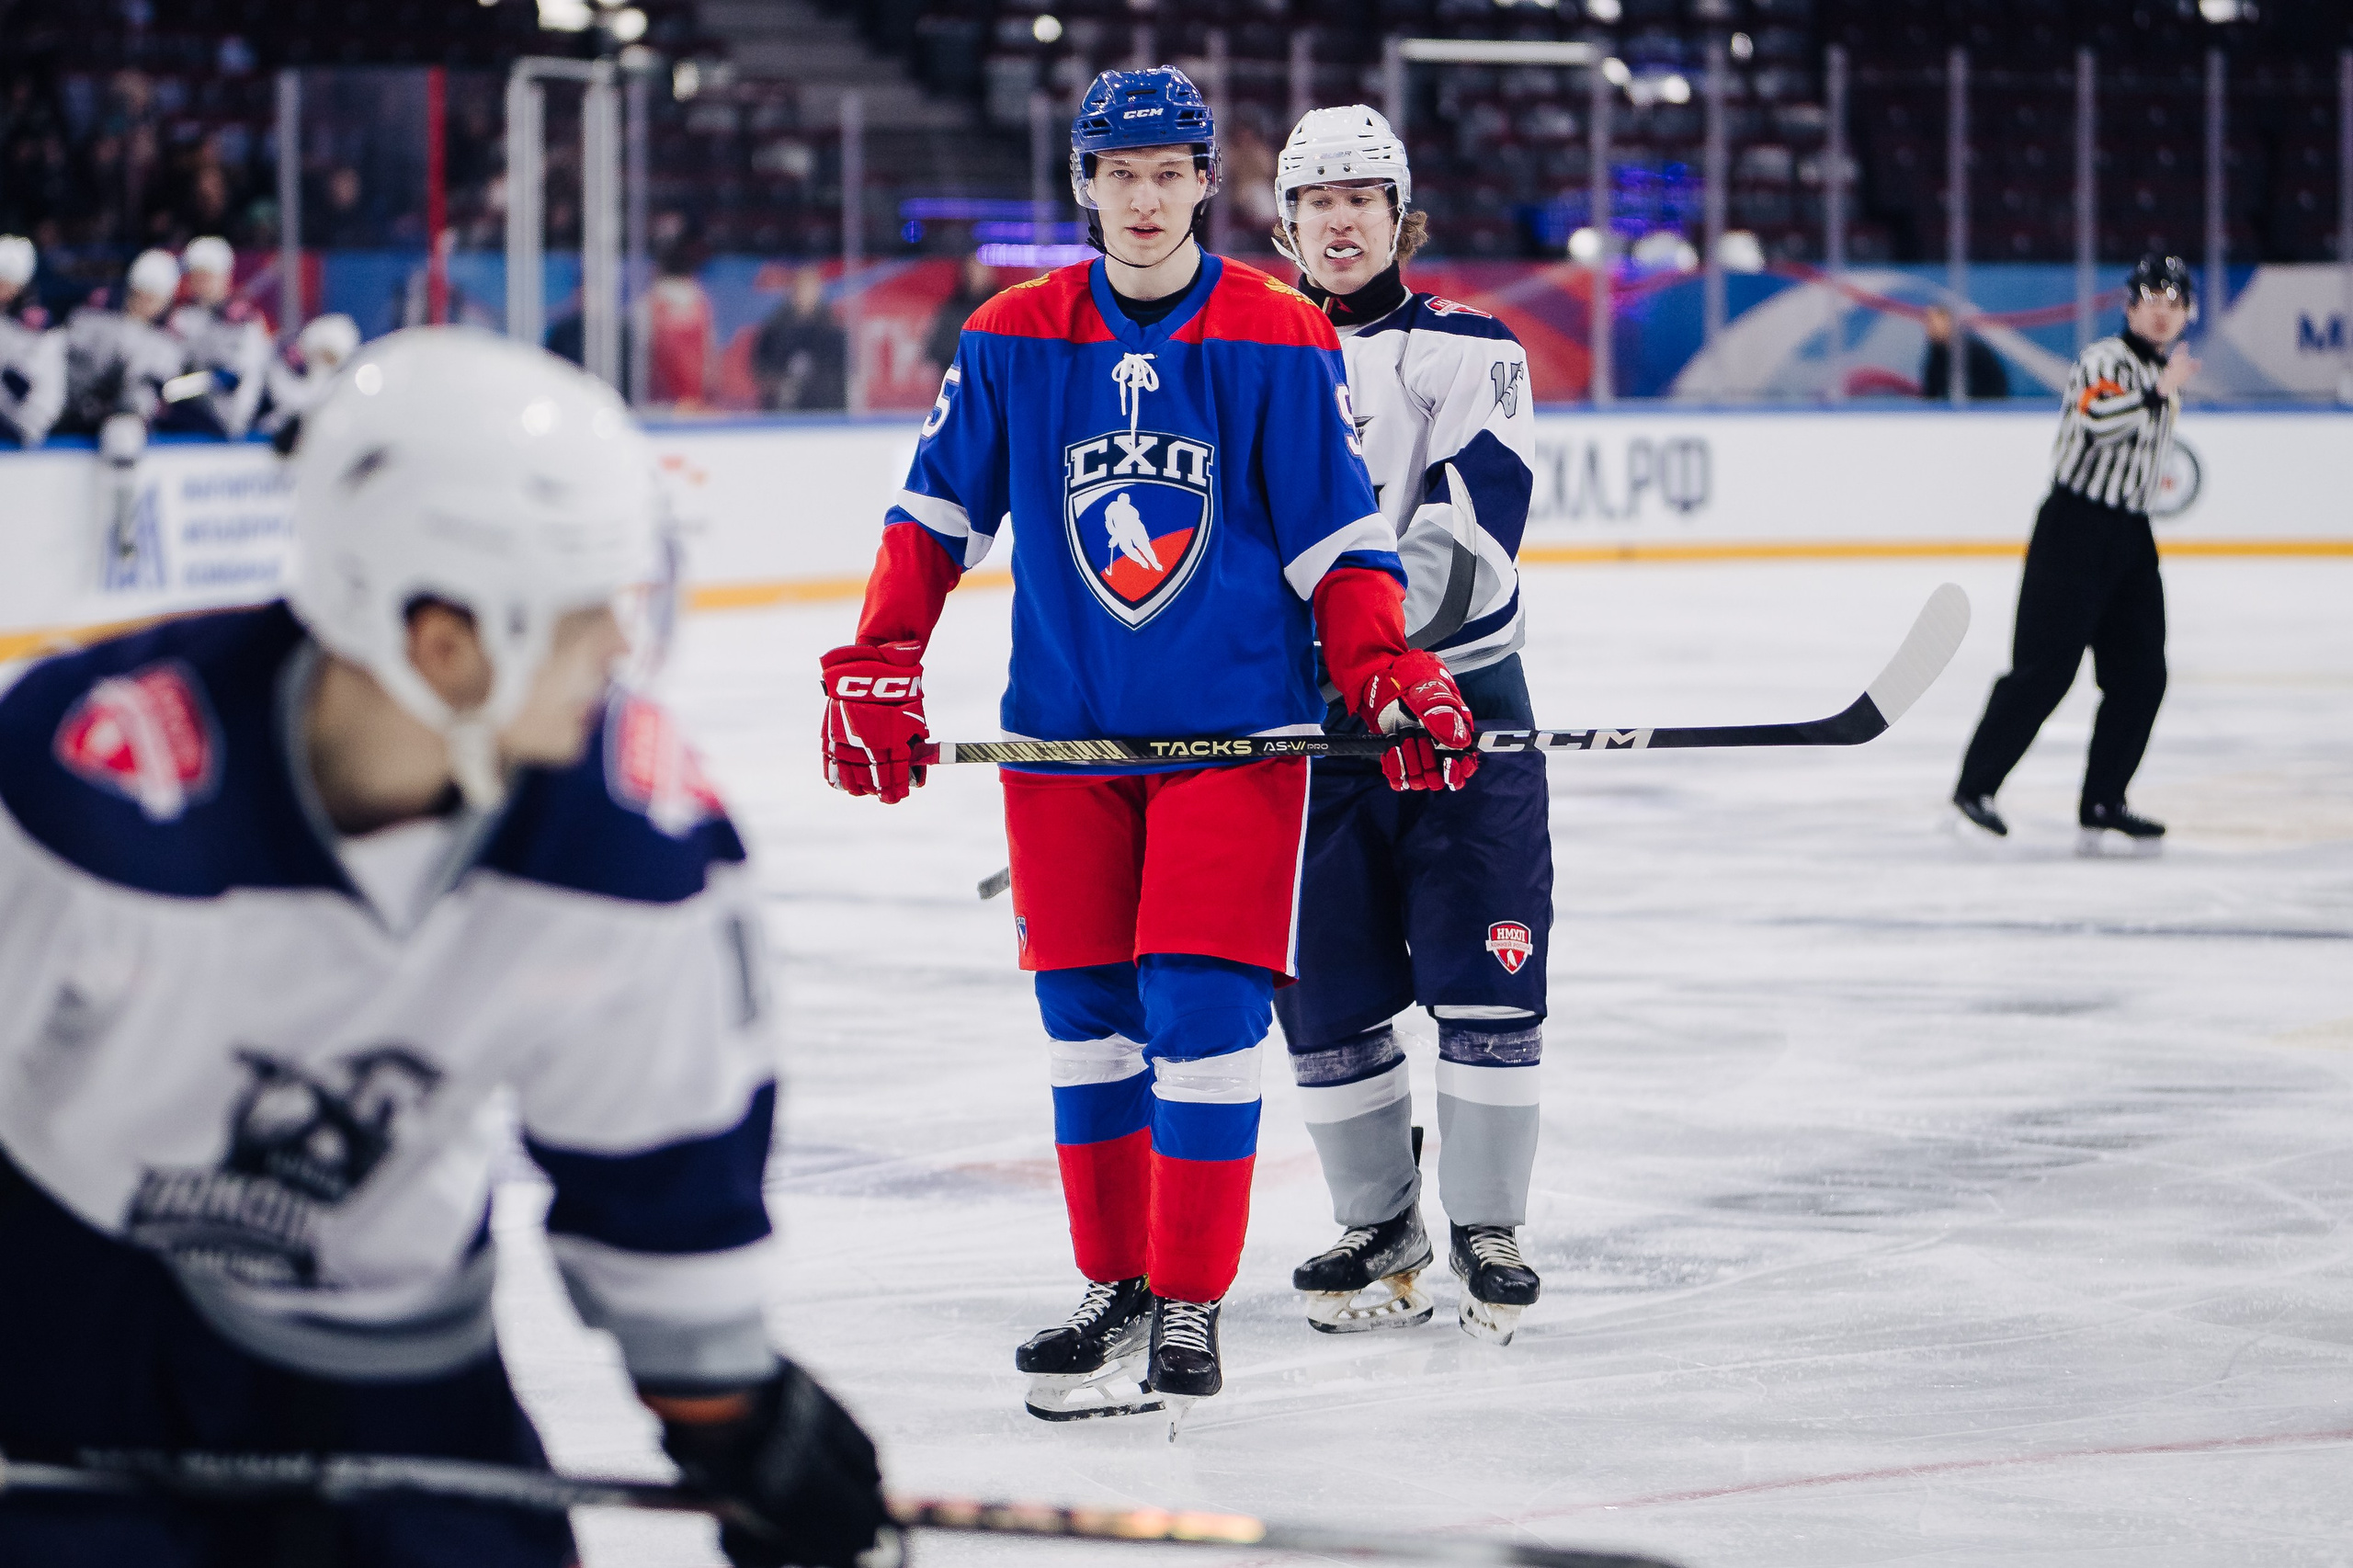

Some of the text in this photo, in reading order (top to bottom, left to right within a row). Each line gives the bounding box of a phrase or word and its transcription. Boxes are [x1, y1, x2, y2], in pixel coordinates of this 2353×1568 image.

[1123, 108, 1165, 119] CCM
[1369, 675, 1380, 709] CCM
[1150, 741, 1252, 756] TACKS
[1306, 743, 1329, 751] PRO
[1476, 727, 1655, 753] CCM
